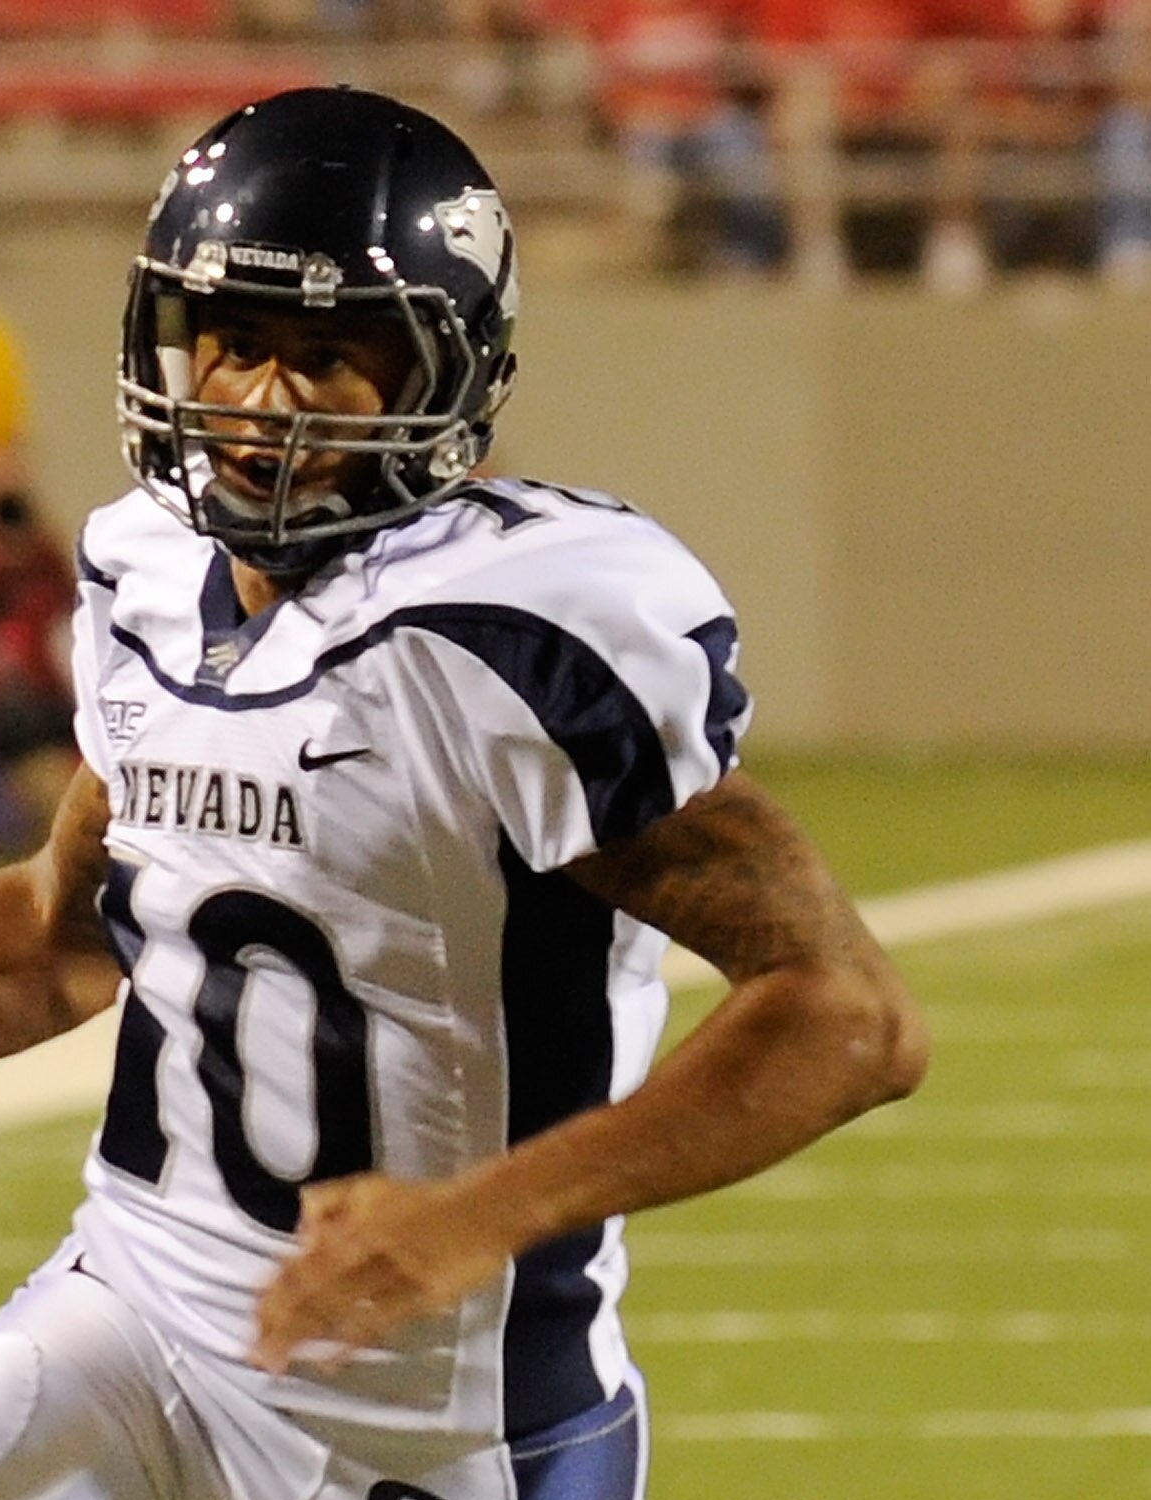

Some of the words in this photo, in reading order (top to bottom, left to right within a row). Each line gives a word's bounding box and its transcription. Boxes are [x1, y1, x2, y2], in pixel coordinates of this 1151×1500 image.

[229, 246, 299, 271] NEVADA
[117, 760, 307, 849] NEVADA
[98, 860, 379, 1235] 10
